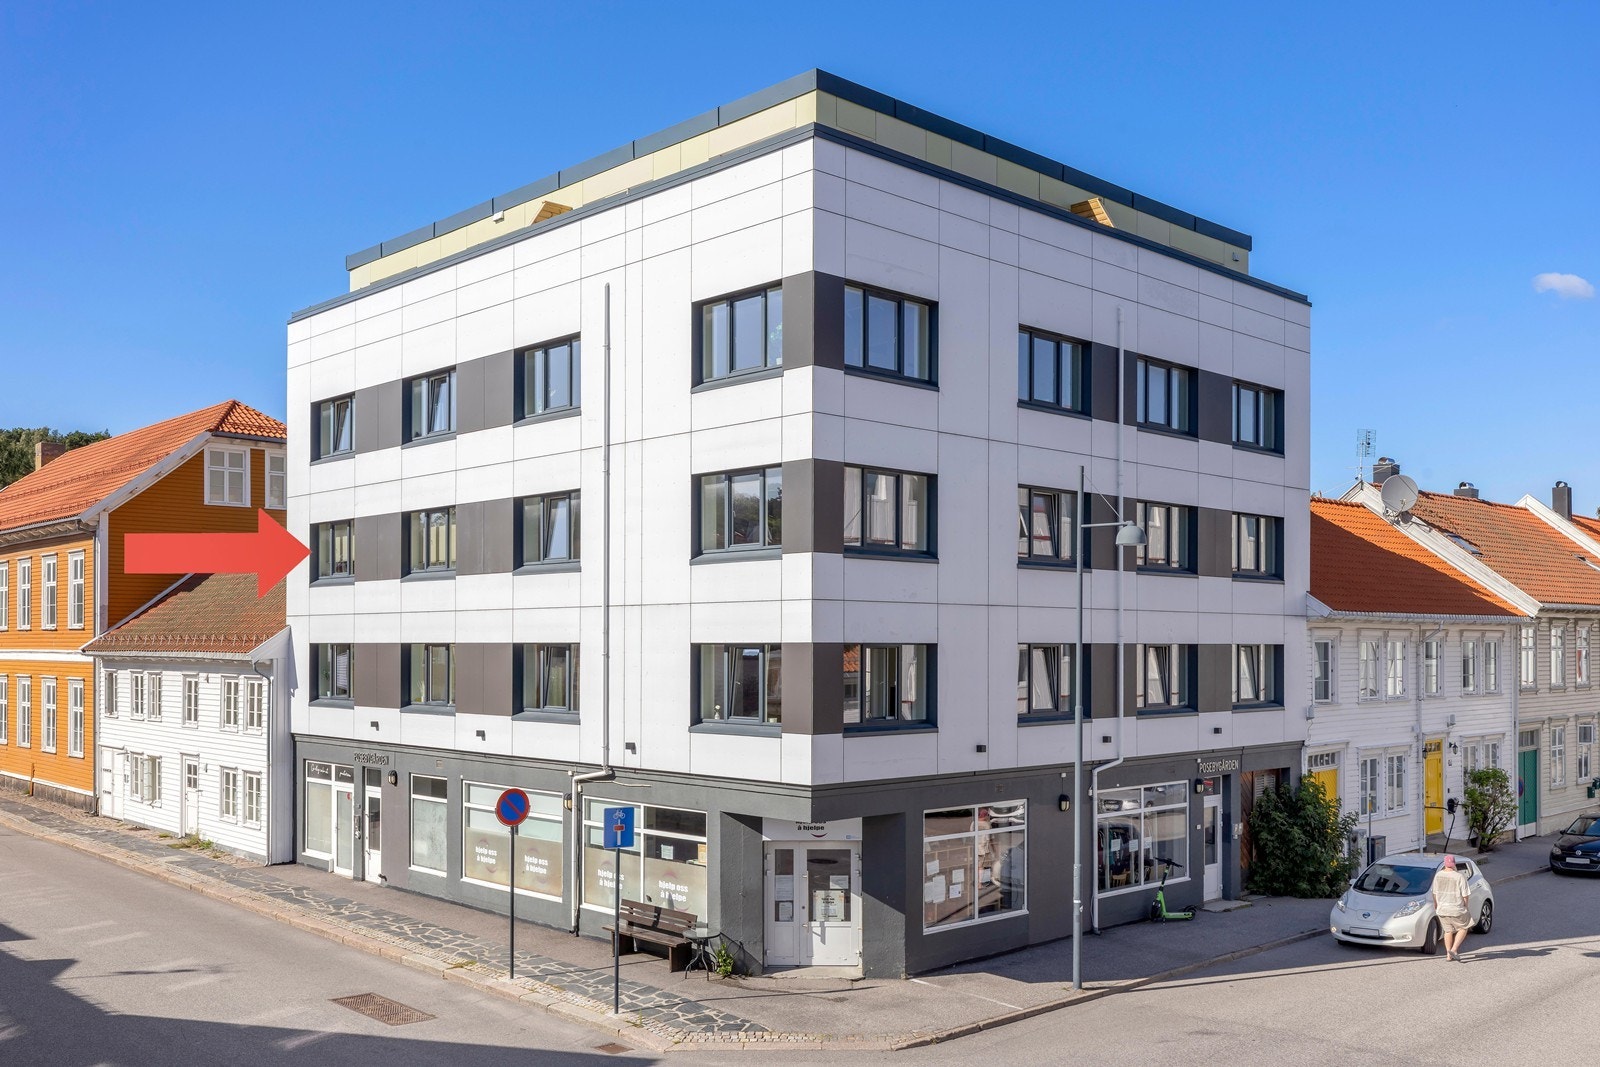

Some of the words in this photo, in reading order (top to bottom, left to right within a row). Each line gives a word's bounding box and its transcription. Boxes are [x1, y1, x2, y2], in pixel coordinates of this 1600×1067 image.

[1199, 759, 1239, 773] POSEBYGÅRDEN
[475, 846, 488, 855] hjelp
[488, 849, 497, 857] oss
[481, 855, 496, 864] hjelpe
[524, 855, 538, 864] hjelp
[539, 858, 548, 866] oss
[530, 865, 547, 874] hjelpe
[597, 869, 612, 879] hjelp
[599, 878, 603, 886] å
[658, 880, 675, 891] hjelp
[676, 884, 689, 893] oss
[660, 890, 665, 898] å
[666, 892, 687, 902] helpe
